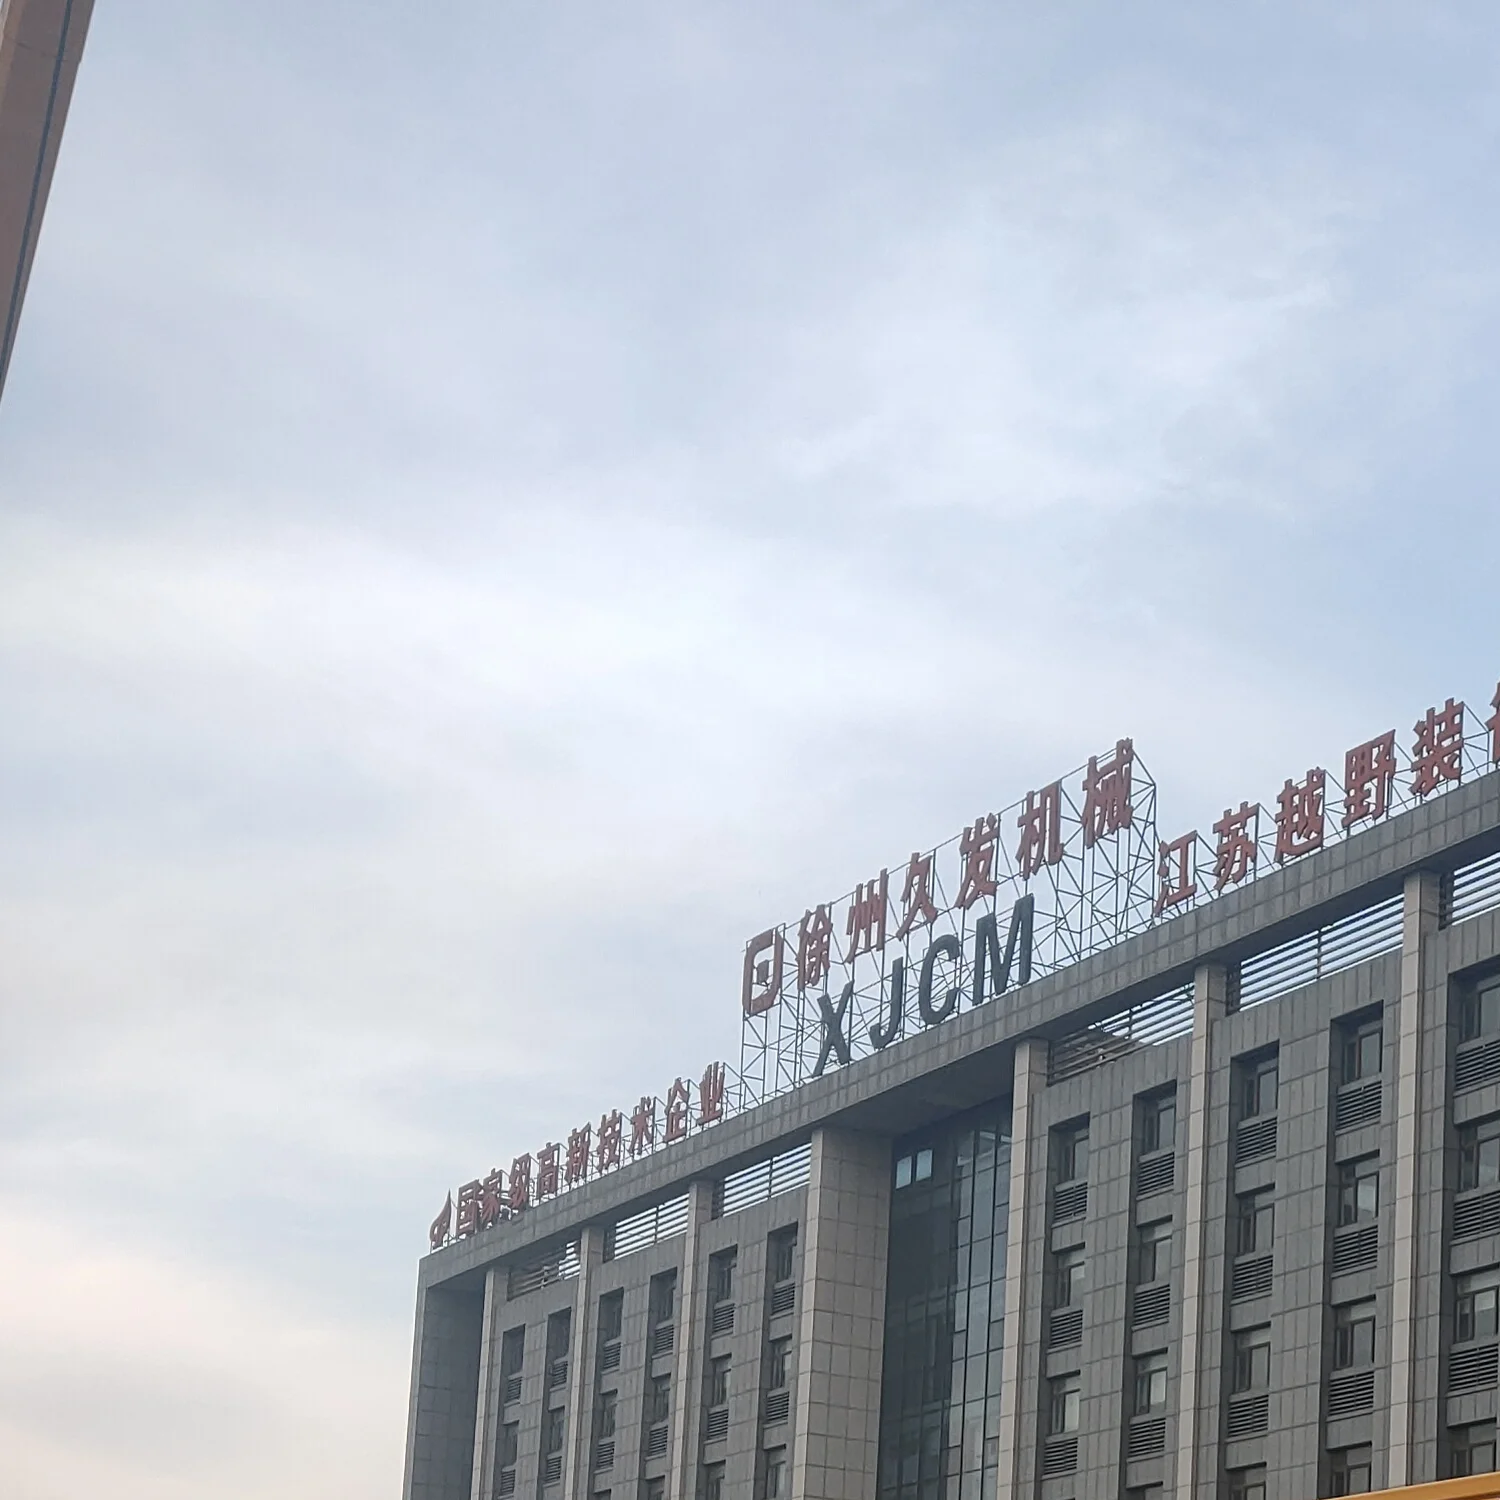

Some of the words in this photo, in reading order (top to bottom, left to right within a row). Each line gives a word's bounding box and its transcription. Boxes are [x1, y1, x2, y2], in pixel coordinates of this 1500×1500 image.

[796, 737, 1133, 990] 徐州久发机械
[812, 893, 1035, 1079] XJCM
